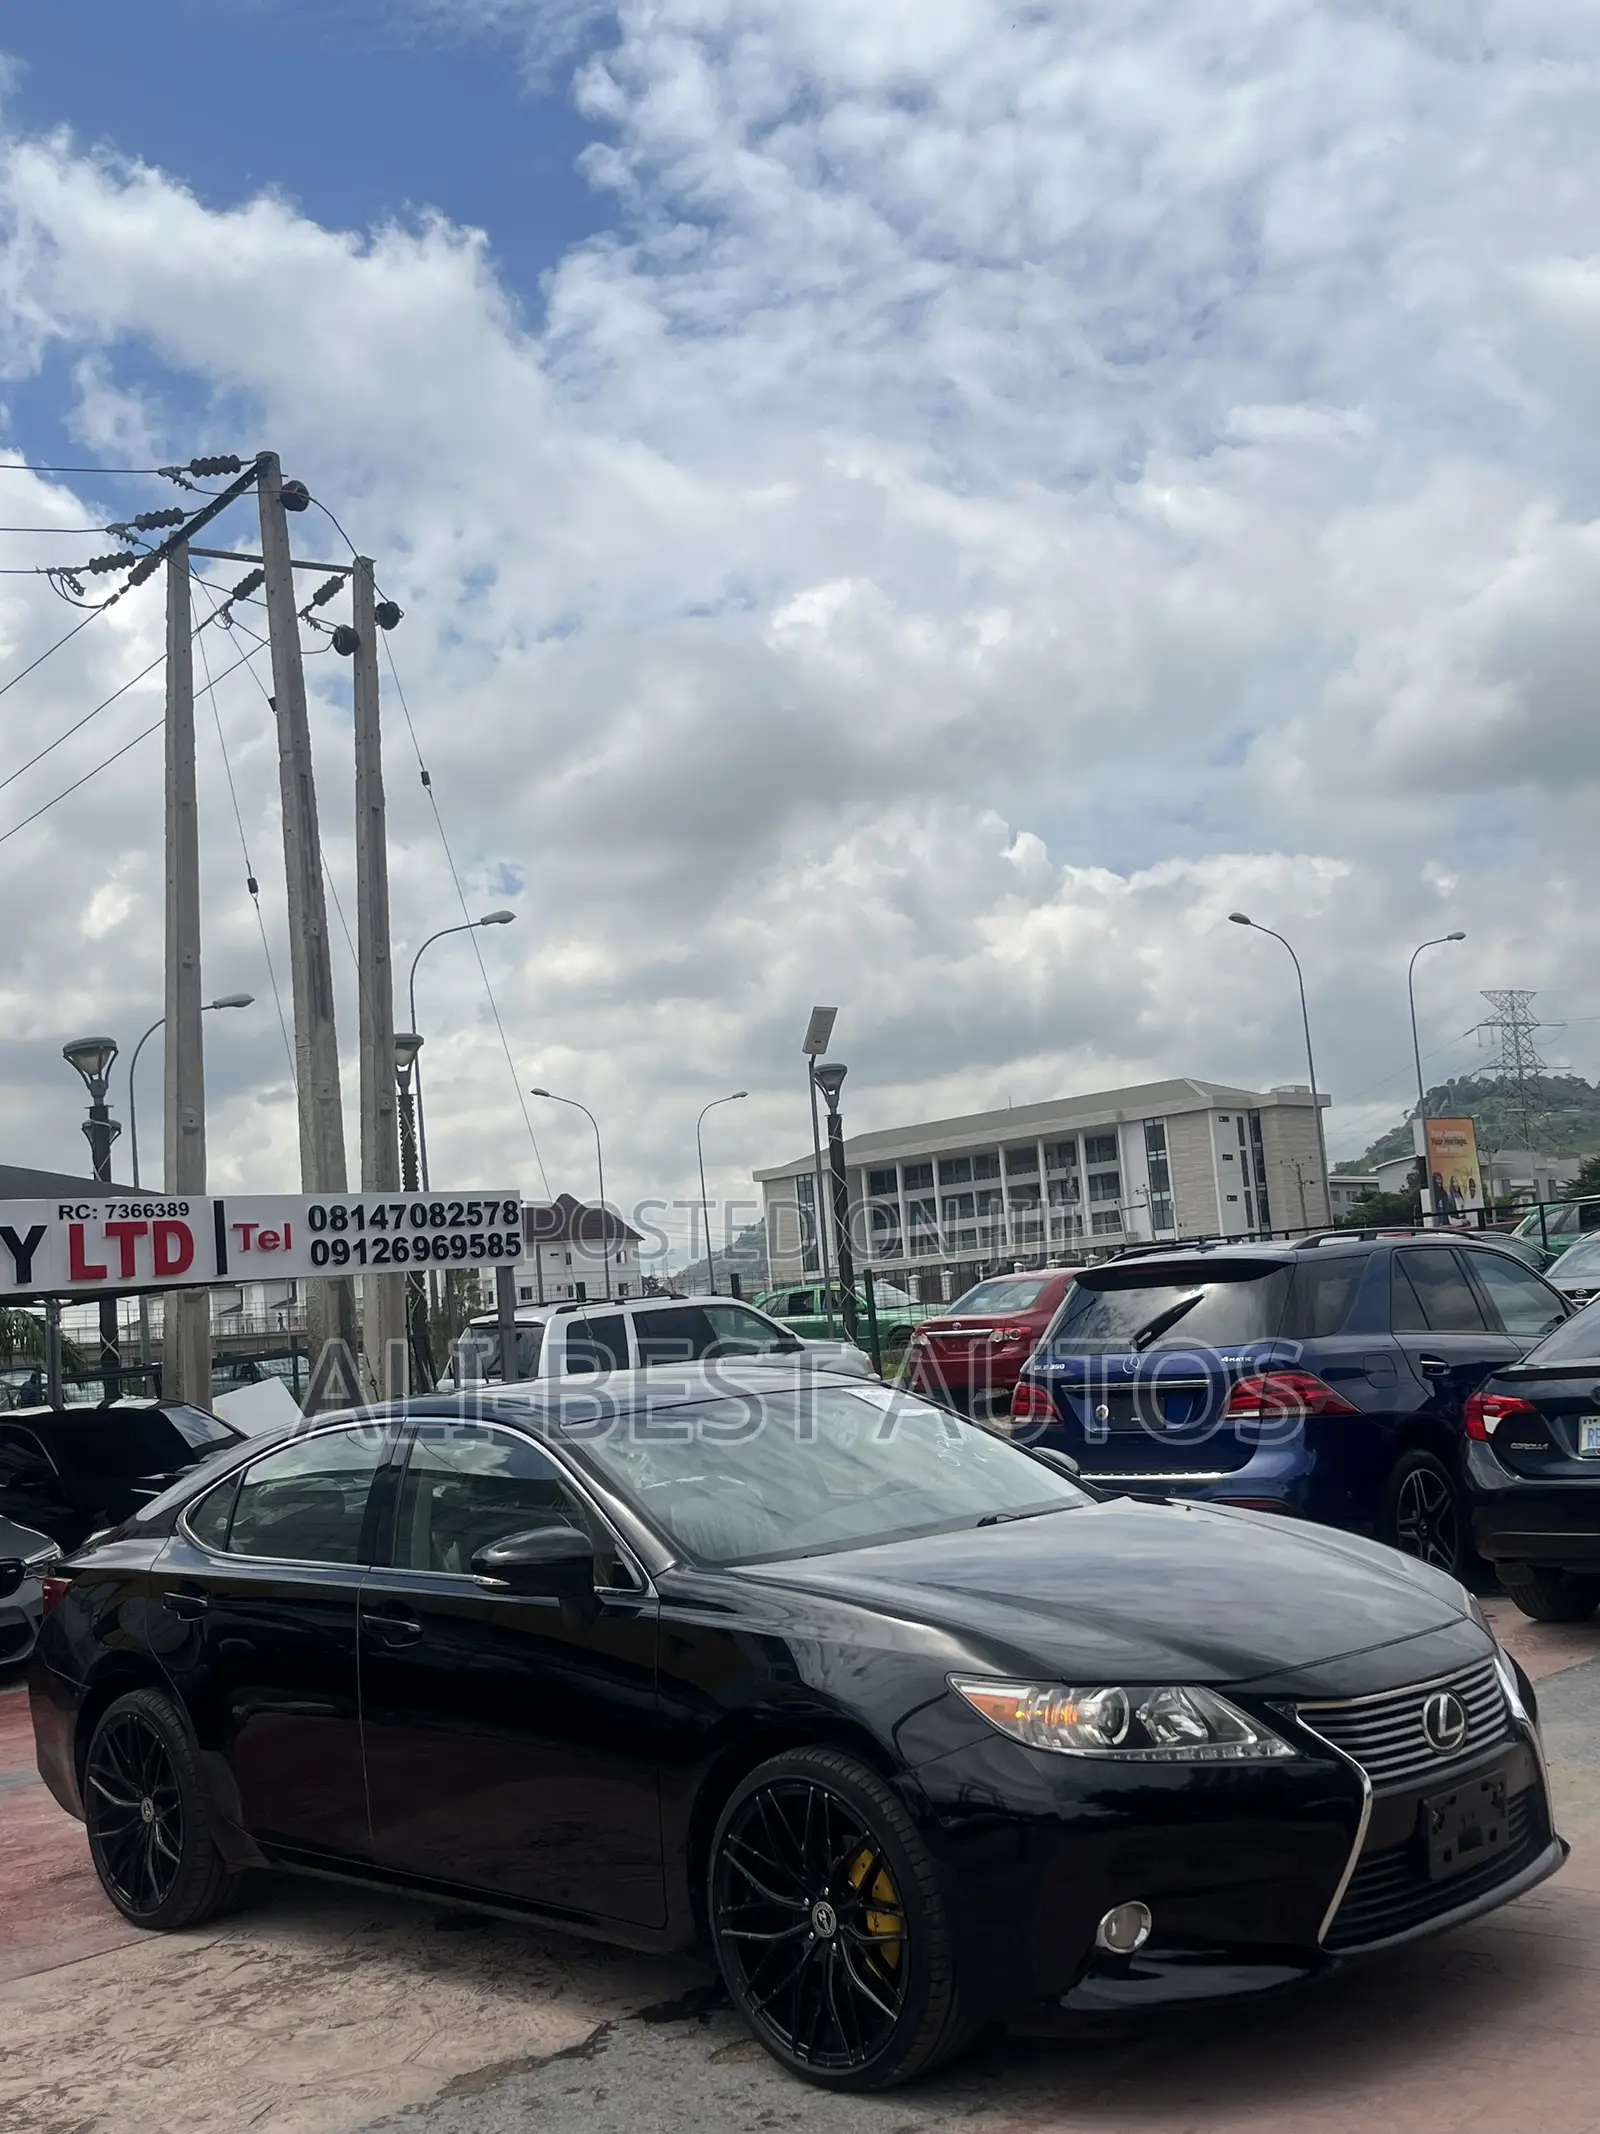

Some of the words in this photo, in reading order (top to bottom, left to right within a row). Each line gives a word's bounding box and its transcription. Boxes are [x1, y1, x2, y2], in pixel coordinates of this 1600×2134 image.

[58, 1205, 98, 1220] RC:
[105, 1202, 190, 1219] 7366389
[307, 1200, 519, 1232] 08147082578
[69, 1220, 195, 1281] LTD
[231, 1223, 292, 1252] Tel
[310, 1232, 521, 1267] 09126969585
